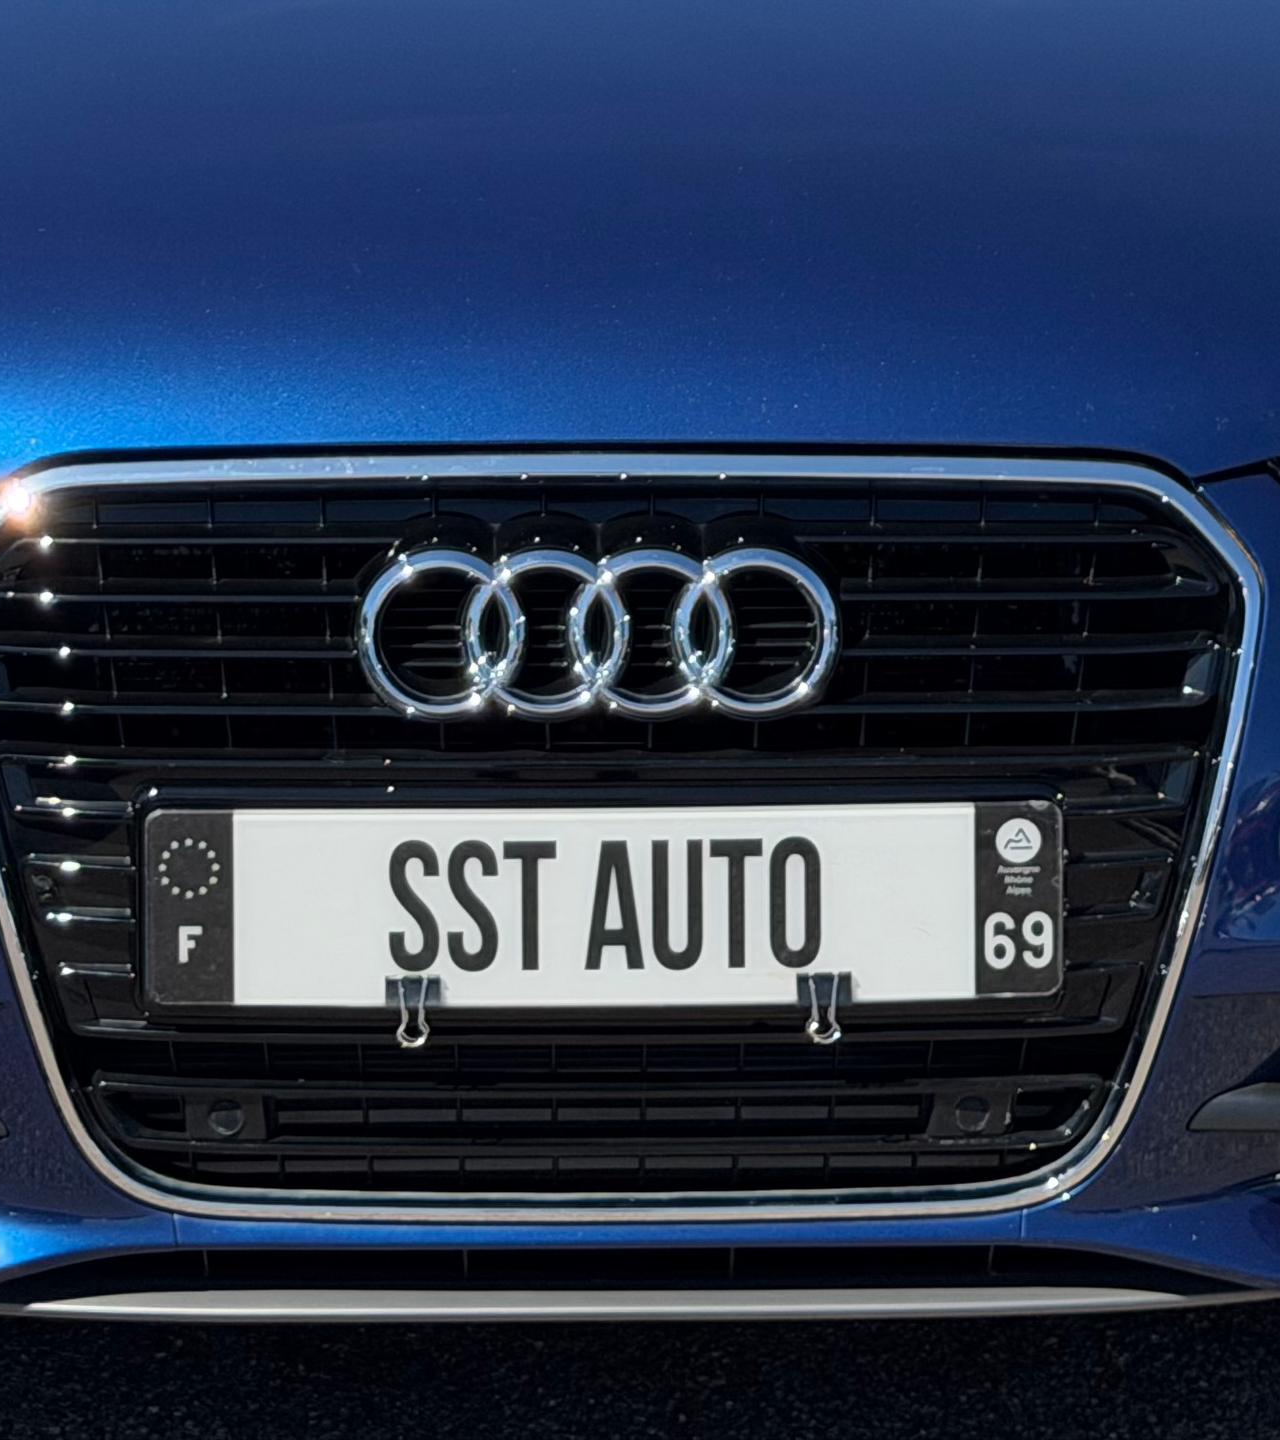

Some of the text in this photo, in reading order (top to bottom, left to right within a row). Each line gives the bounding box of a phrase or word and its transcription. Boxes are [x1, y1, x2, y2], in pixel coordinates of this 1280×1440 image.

[388, 836, 821, 972] SST AUTO
[178, 925, 203, 964] F
[984, 911, 1054, 970] 69
